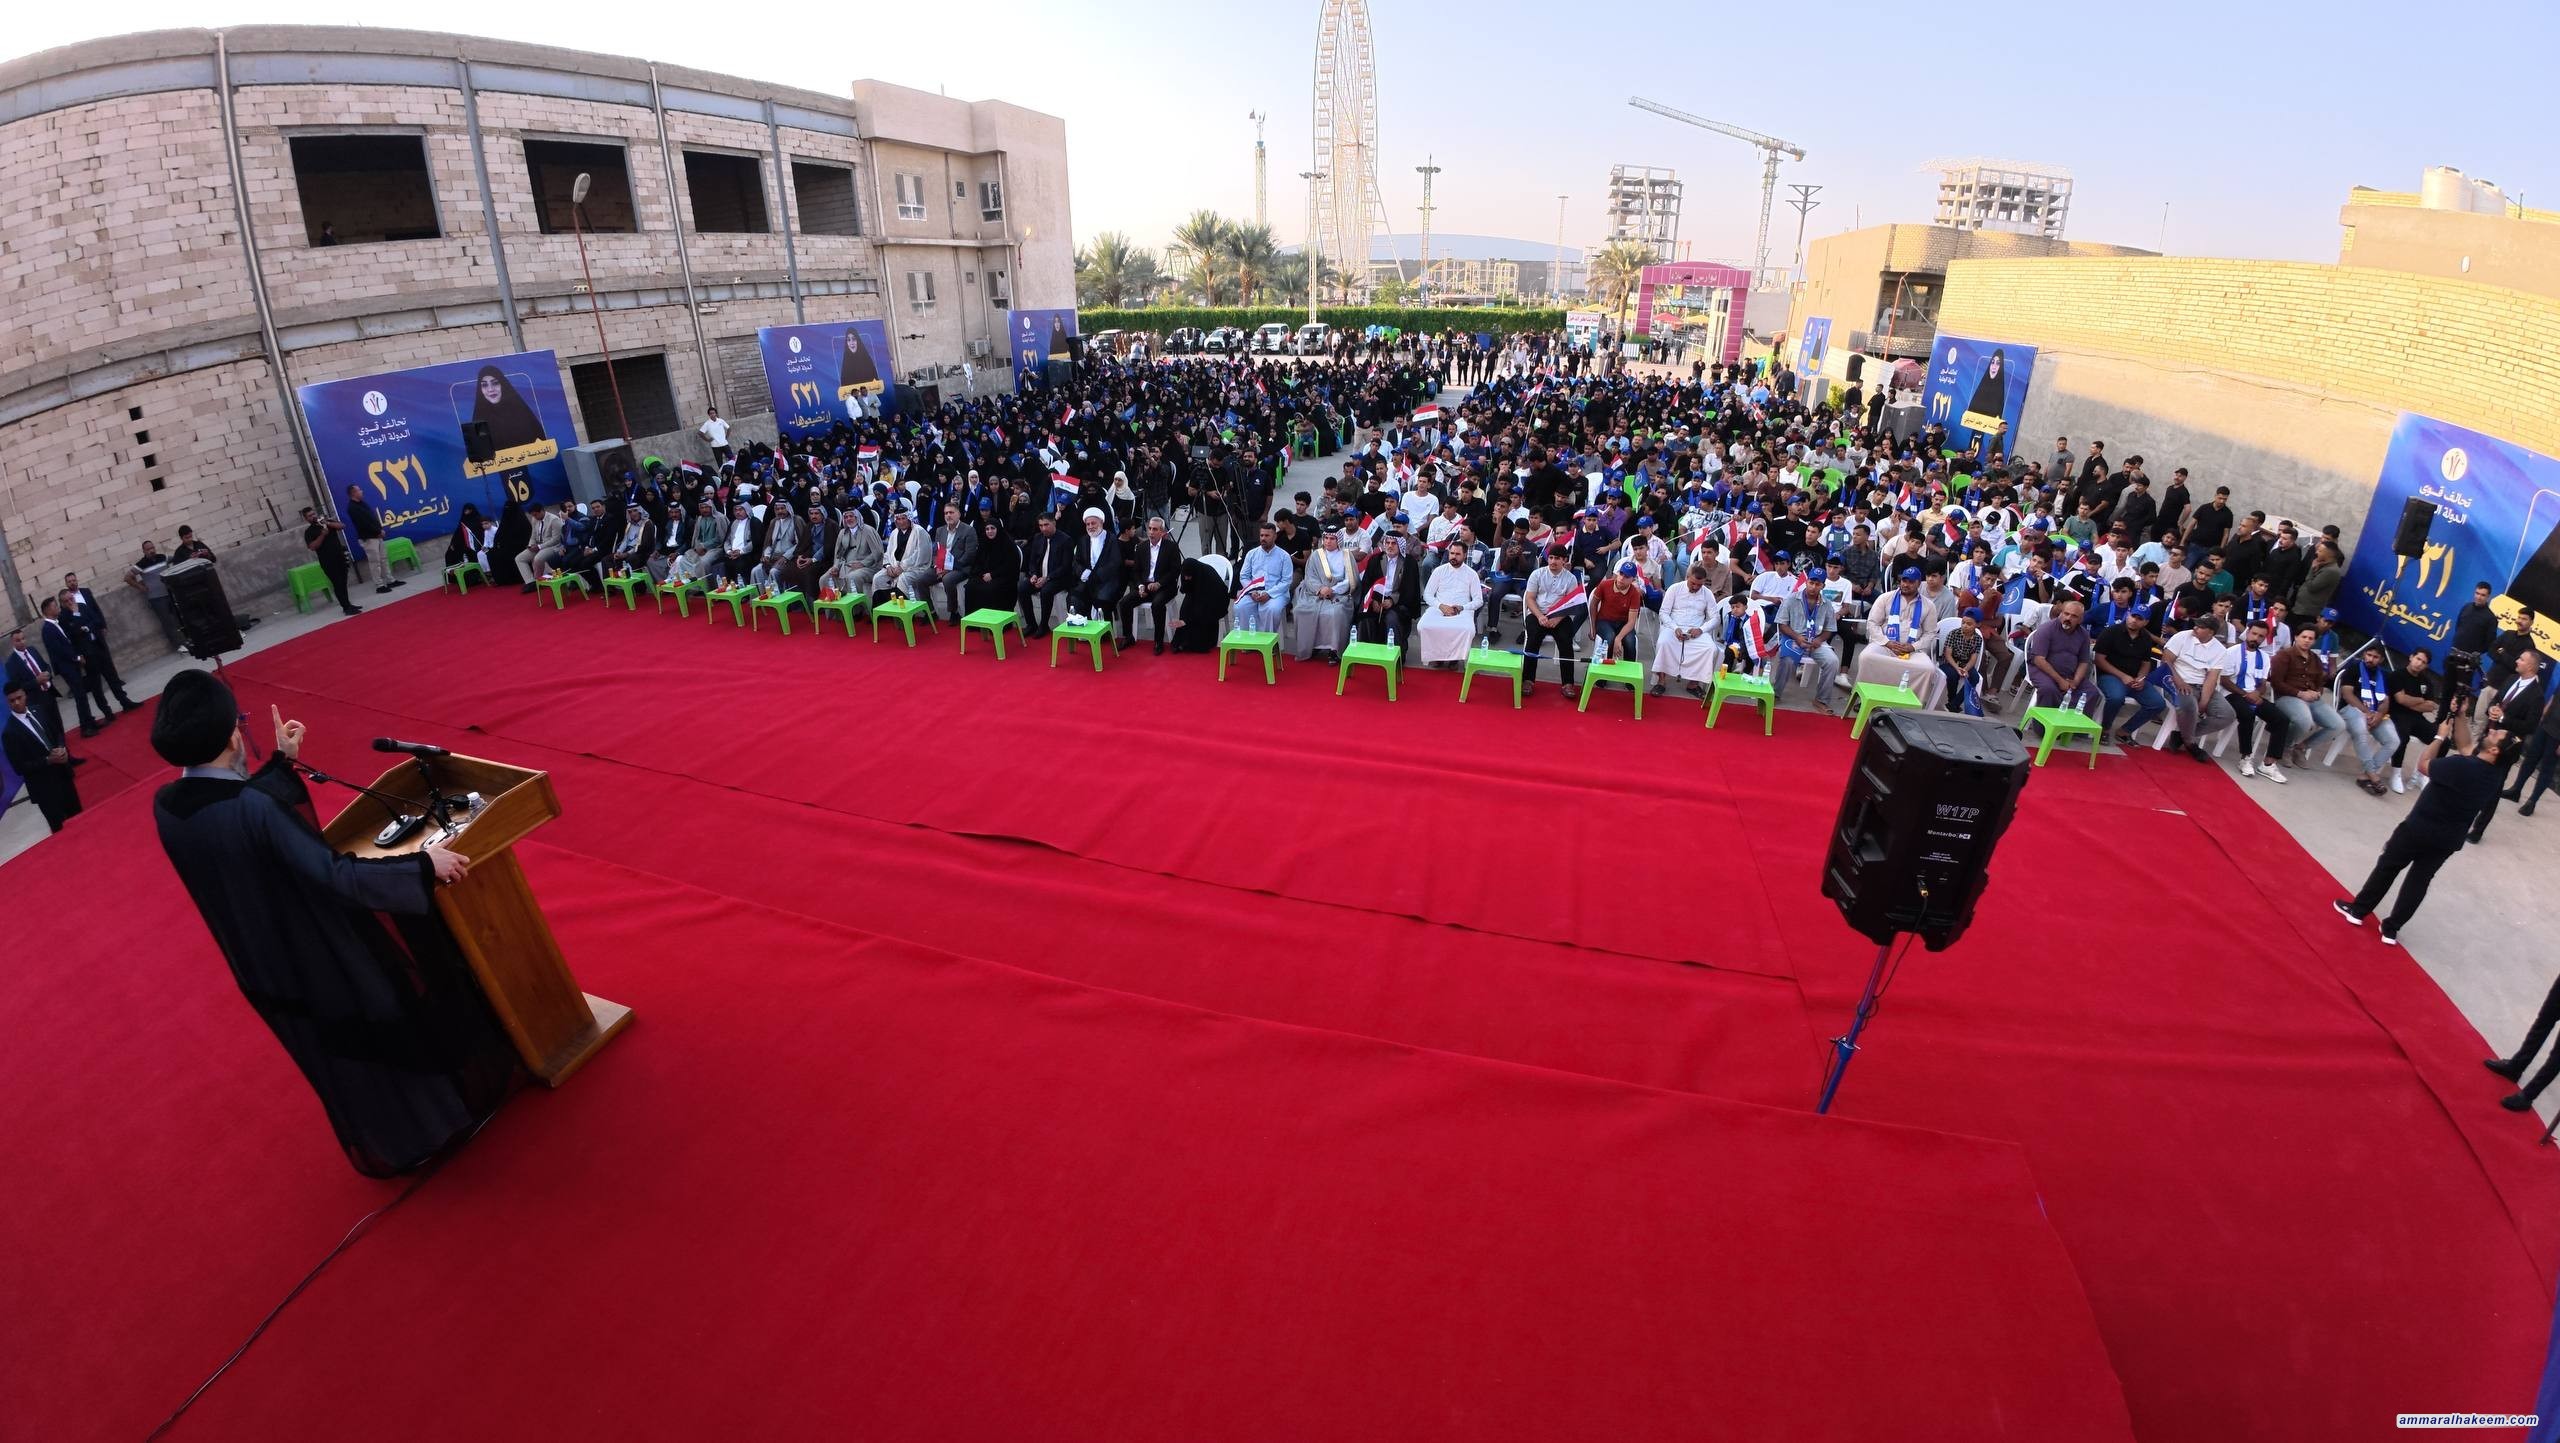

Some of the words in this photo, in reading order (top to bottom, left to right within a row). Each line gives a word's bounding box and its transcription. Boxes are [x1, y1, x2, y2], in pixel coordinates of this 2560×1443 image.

[357, 421, 380, 436] قوى
[381, 417, 407, 430] تحالف
[360, 433, 387, 448] الوطنية
[387, 428, 411, 442] الدولة
[368, 453, 427, 500] ٢٣١
[508, 480, 529, 502] ١٥
[2418, 484, 2445, 498] قوى
[2443, 490, 2473, 508] تحالف
[2442, 506, 2468, 525] الدولة
[1936, 804, 1980, 819] W17P
